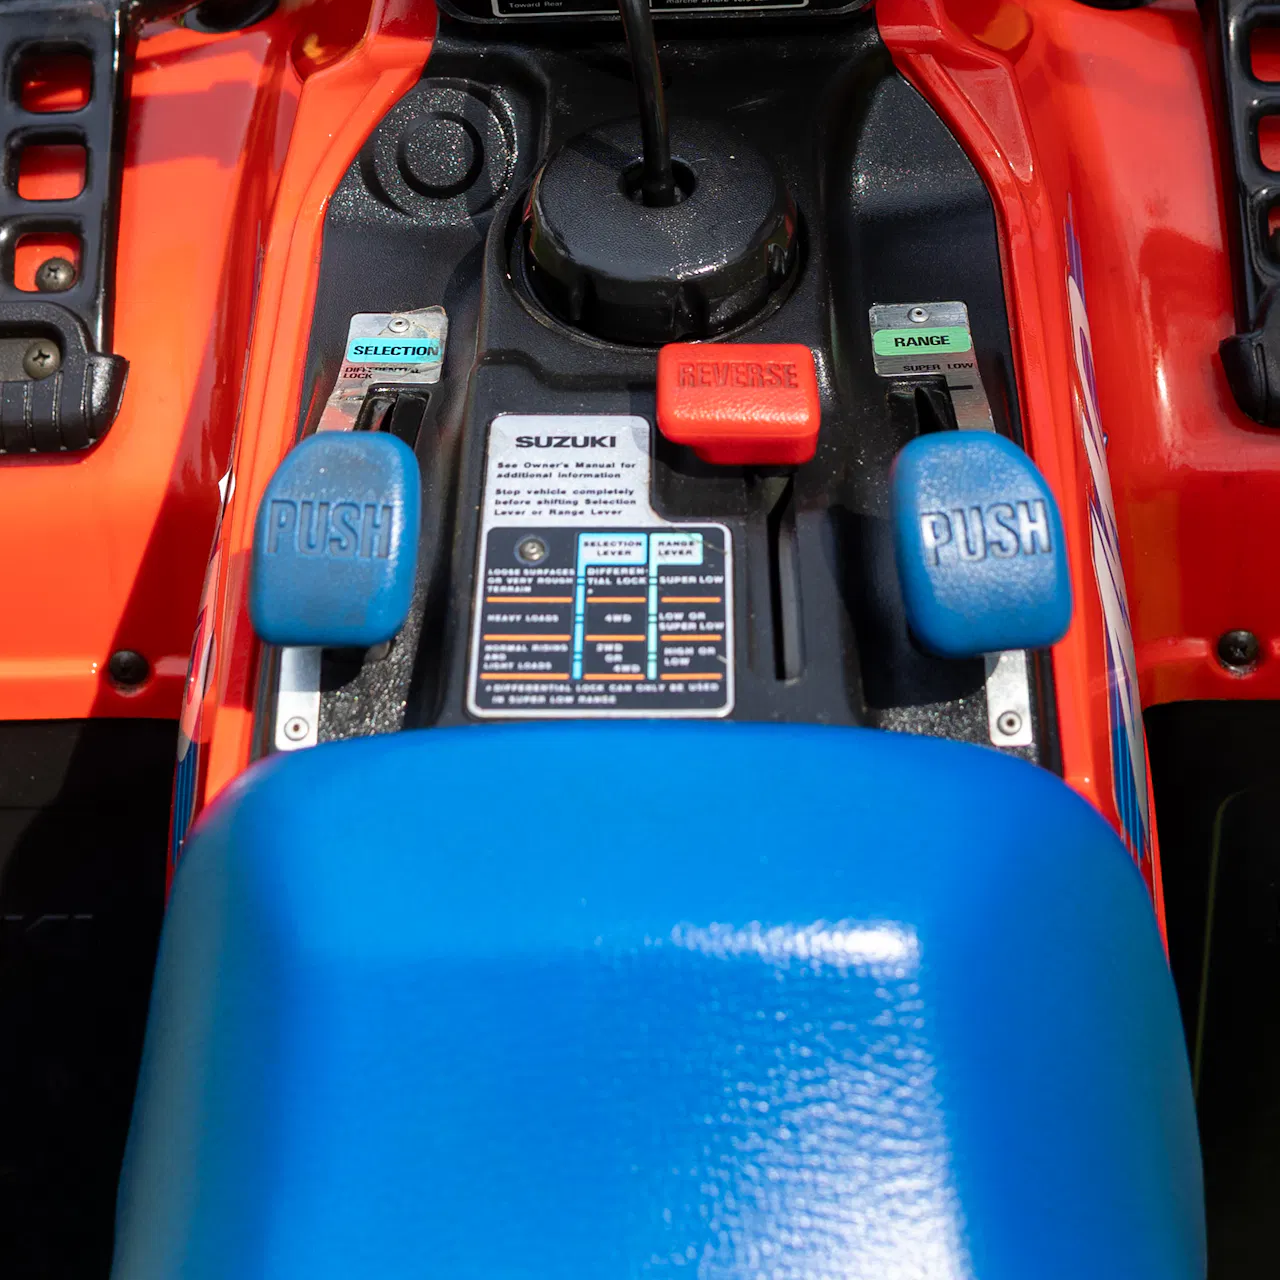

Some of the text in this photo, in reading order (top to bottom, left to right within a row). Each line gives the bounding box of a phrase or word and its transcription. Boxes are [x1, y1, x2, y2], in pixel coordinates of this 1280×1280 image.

[508, 1, 541, 9] Toward
[893, 335, 951, 348] RANGE
[353, 345, 439, 356] SELECTION
[903, 362, 974, 372] SUPER LOW
[678, 361, 799, 389] REVERSE
[515, 435, 617, 449] SUZUKI
[497, 461, 637, 469] See Owner's Manual for
[496, 471, 621, 479] additional information
[495, 488, 635, 496] Stop vehicle completely
[494, 498, 637, 507] before shifting Selection
[494, 508, 526, 516] Lever
[549, 508, 585, 517] Range
[590, 508, 623, 516] Lever
[266, 498, 394, 559] PUSH
[920, 497, 1053, 567] PUSH
[583, 540, 642, 548] SELECTION
[596, 549, 632, 557] LEVER
[487, 567, 576, 576] LOOSE SURFACES
[487, 576, 574, 585] OR VERY ROUGH
[587, 576, 648, 586] TIAL LOCK
[658, 575, 725, 585] SUPER LOW
[487, 585, 532, 594] TERRAIN
[486, 613, 560, 623] HEAVY LOADS
[603, 613, 633, 623] 4WD
[658, 611, 707, 621] LOW OR
[658, 621, 726, 631] SUPER LOW
[697, 646, 717, 656] OR
[663, 657, 691, 667] LOW
